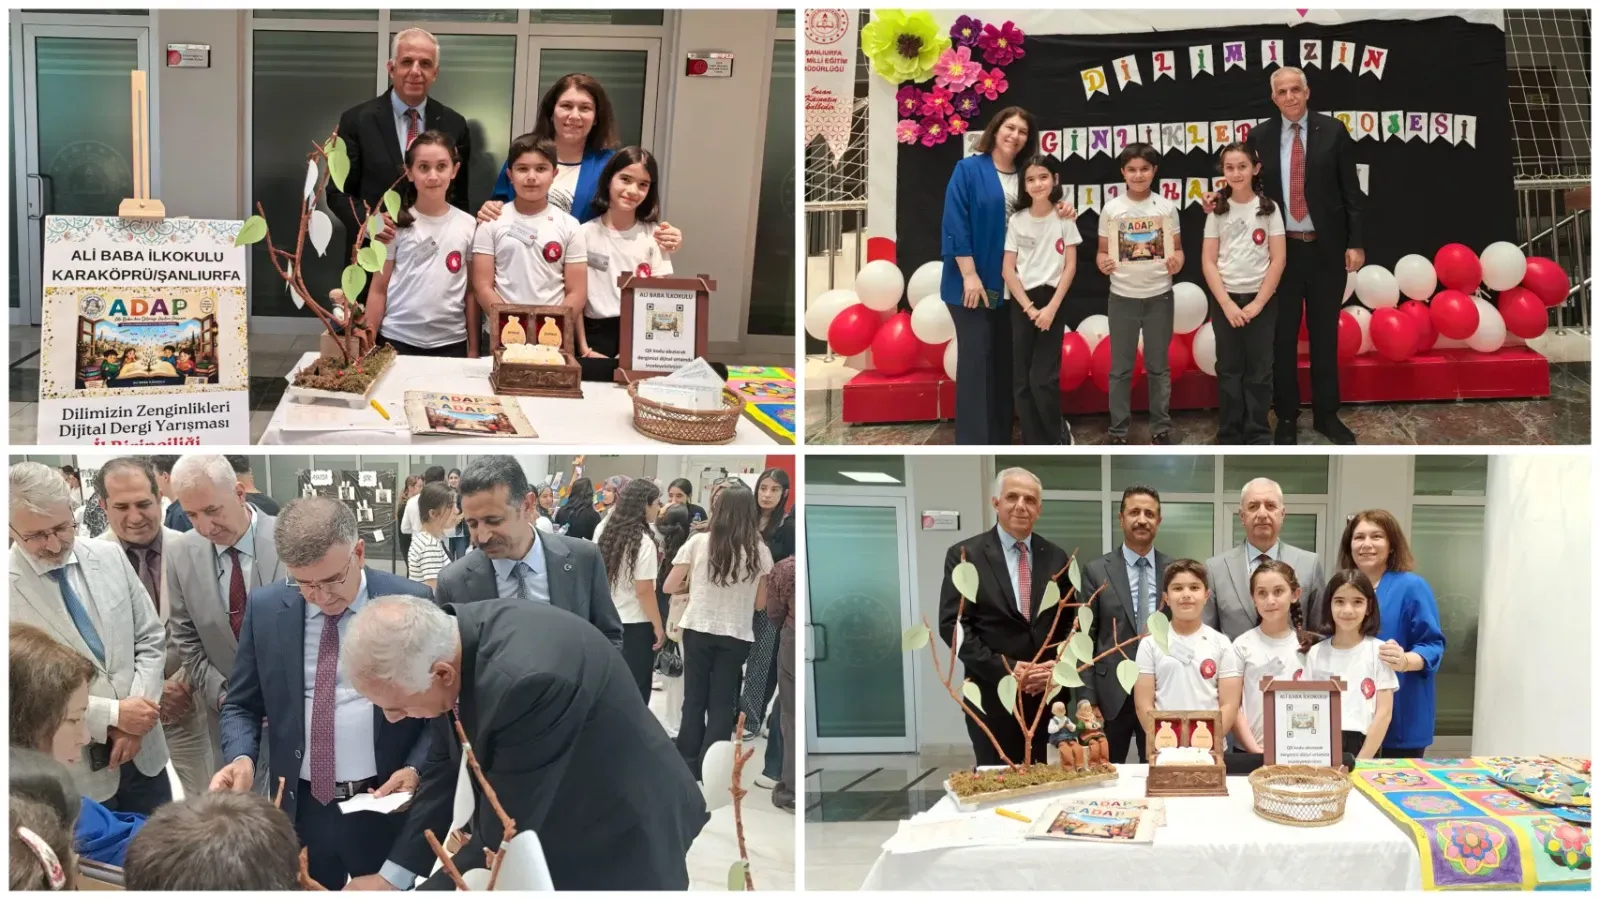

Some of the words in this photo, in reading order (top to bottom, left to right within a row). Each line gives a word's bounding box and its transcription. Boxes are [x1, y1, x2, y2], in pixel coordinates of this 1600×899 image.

[71, 248, 97, 262] ALİ
[100, 250, 144, 262] BABA
[148, 248, 224, 263] İLKOKULU
[52, 267, 241, 283] KARAKÖPRÜ/ŞANLIURFA
[108, 298, 188, 317] ADAP
[62, 406, 133, 421] Dilimizin
[136, 401, 231, 419] Zenginlikleri
[59, 422, 106, 439] Dijital
[110, 421, 152, 435] Dergi
[155, 419, 230, 433] Yarışması
